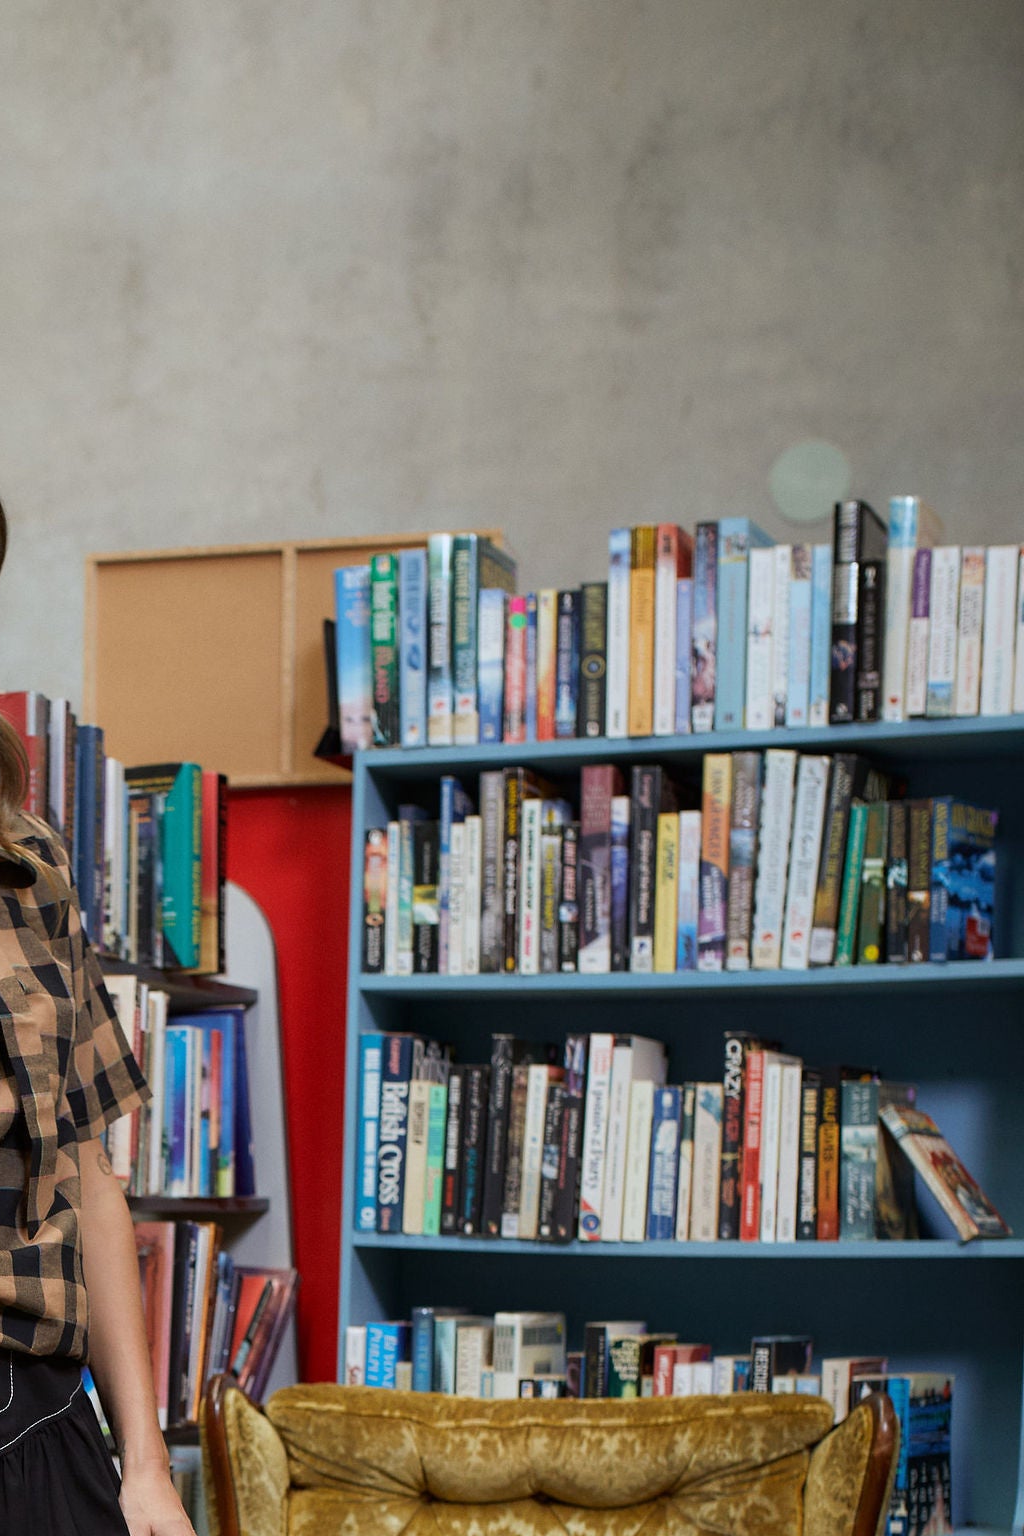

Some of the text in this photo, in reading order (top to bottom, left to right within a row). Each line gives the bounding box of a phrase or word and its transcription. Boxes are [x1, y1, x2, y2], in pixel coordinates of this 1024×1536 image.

[723, 1039, 742, 1100] CRAZY
[378, 1081, 409, 1205] British Cross
